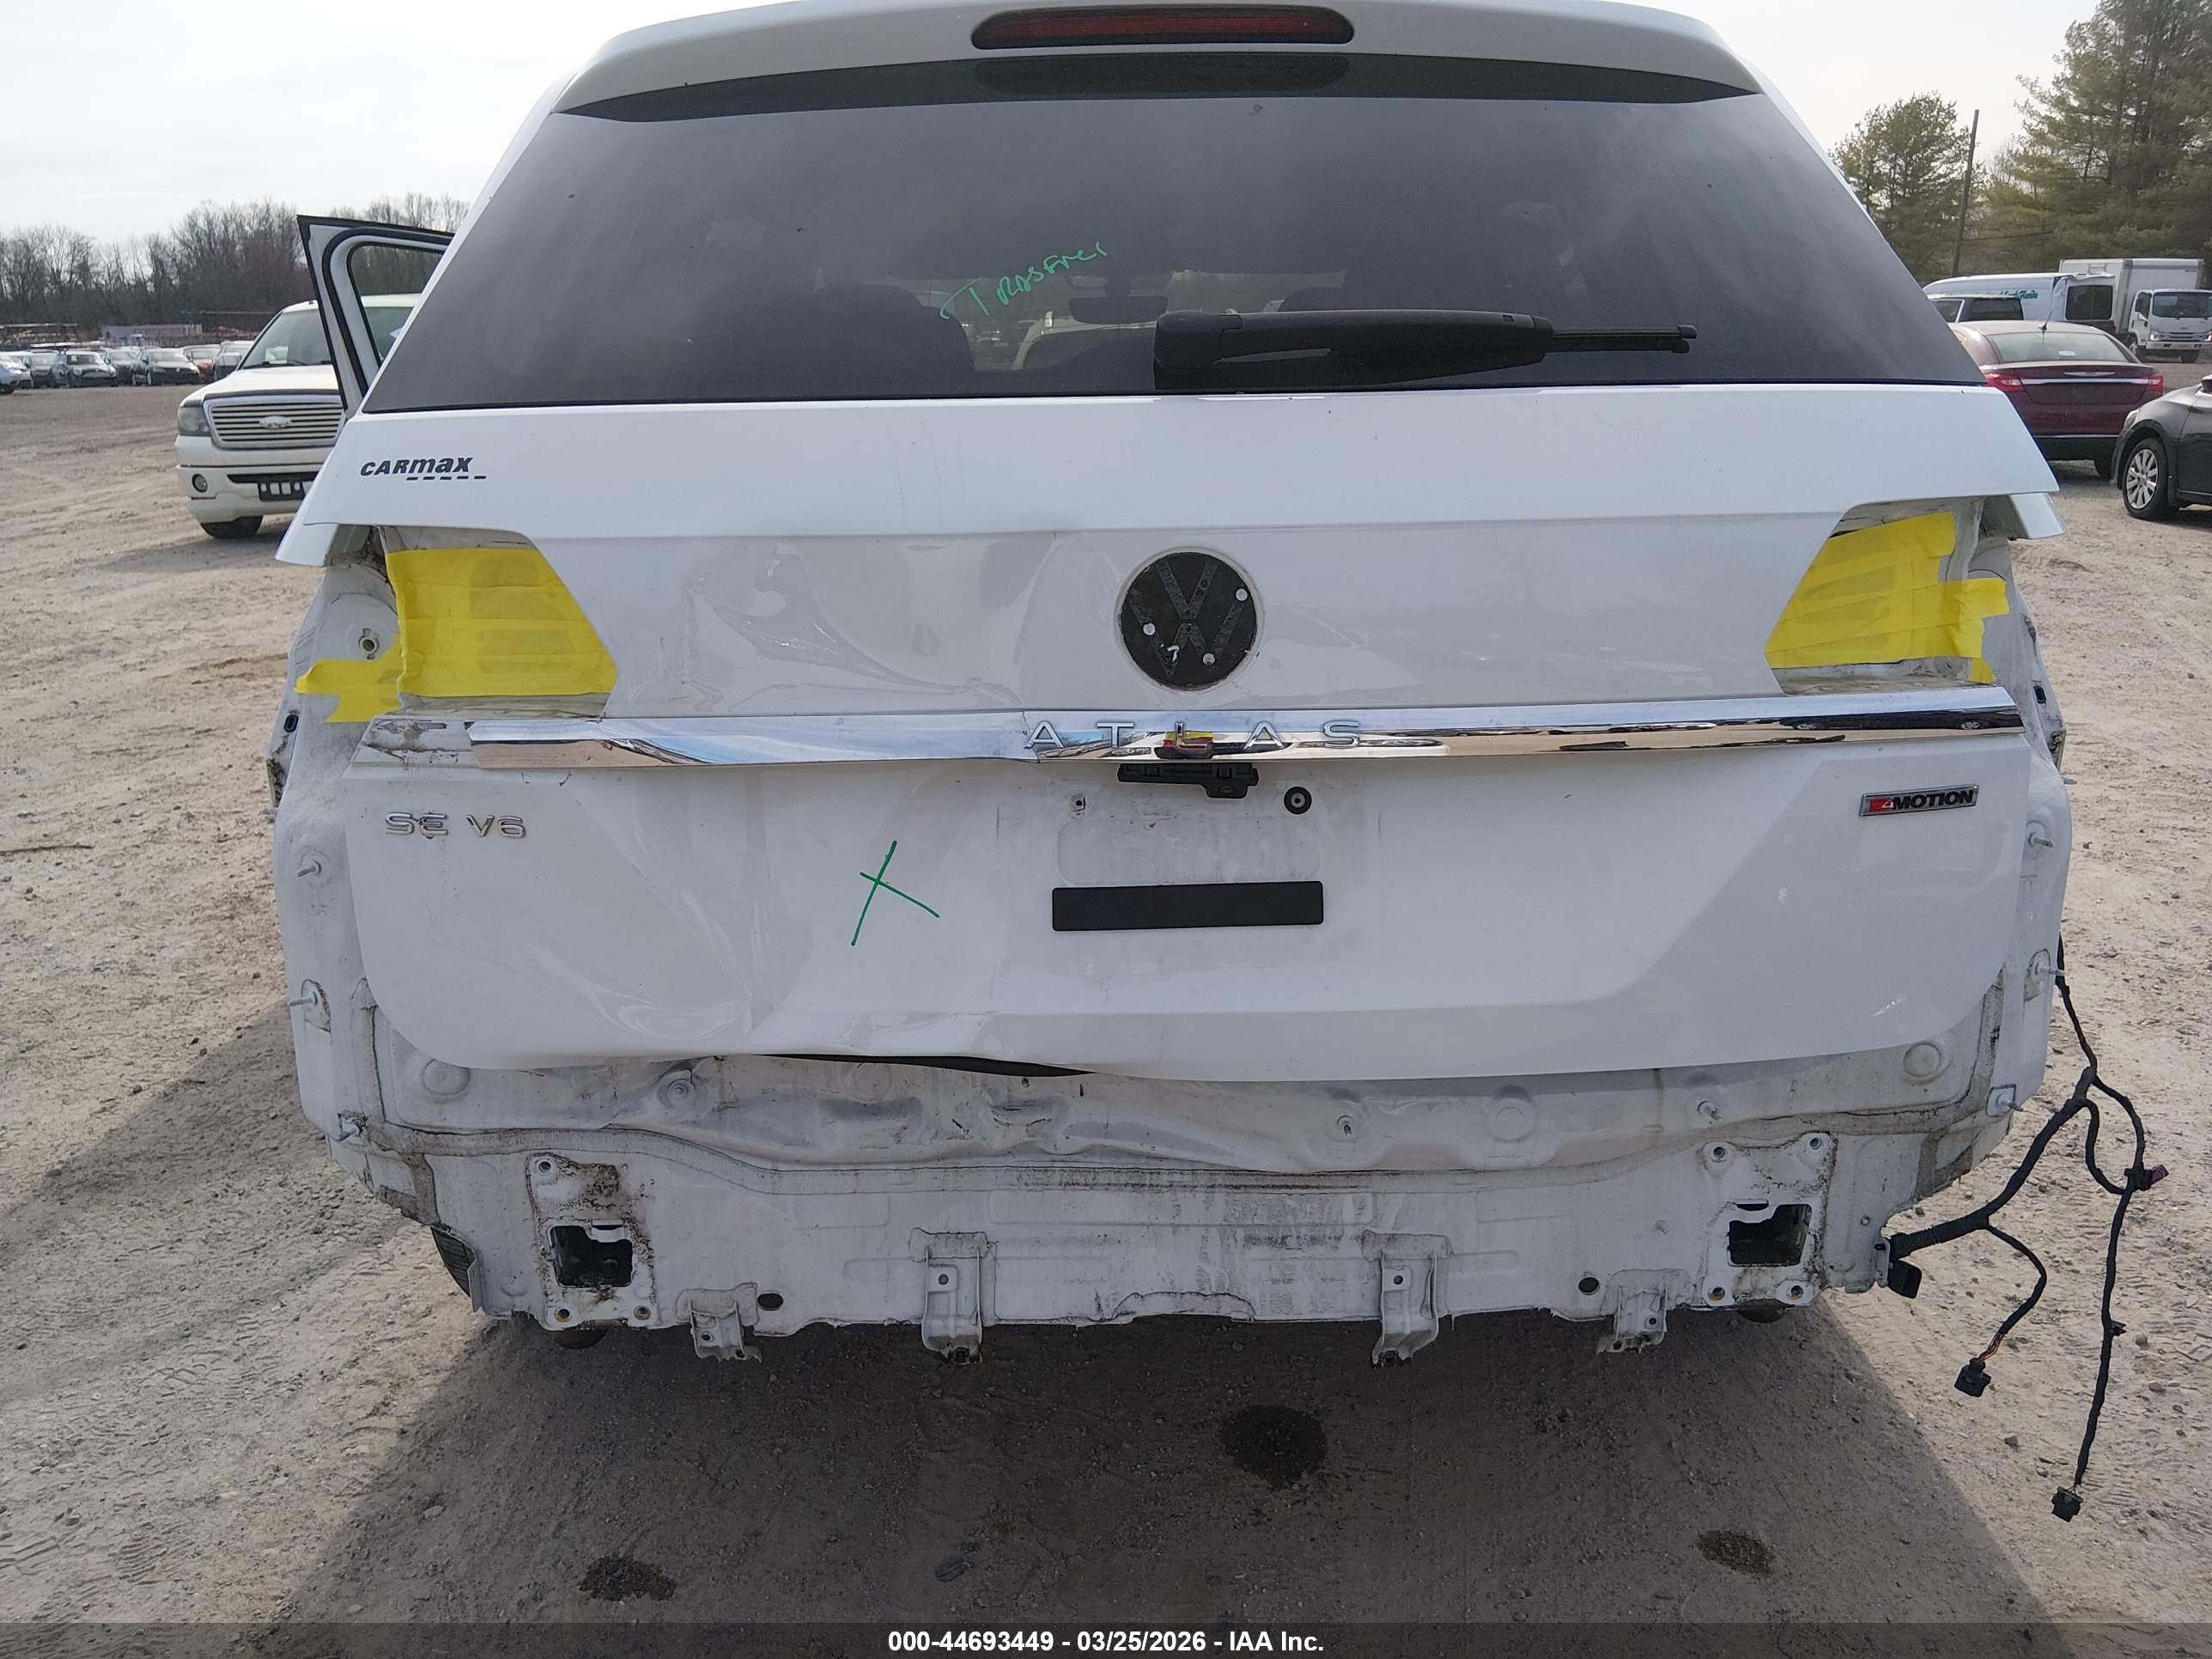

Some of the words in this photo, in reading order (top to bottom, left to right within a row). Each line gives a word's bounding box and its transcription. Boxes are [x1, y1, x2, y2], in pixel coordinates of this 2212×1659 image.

[1029, 720, 1362, 750] ATLAS
[1869, 789, 1974, 812] 4MOTION
[386, 811, 449, 839] SE
[466, 814, 526, 839] V6
